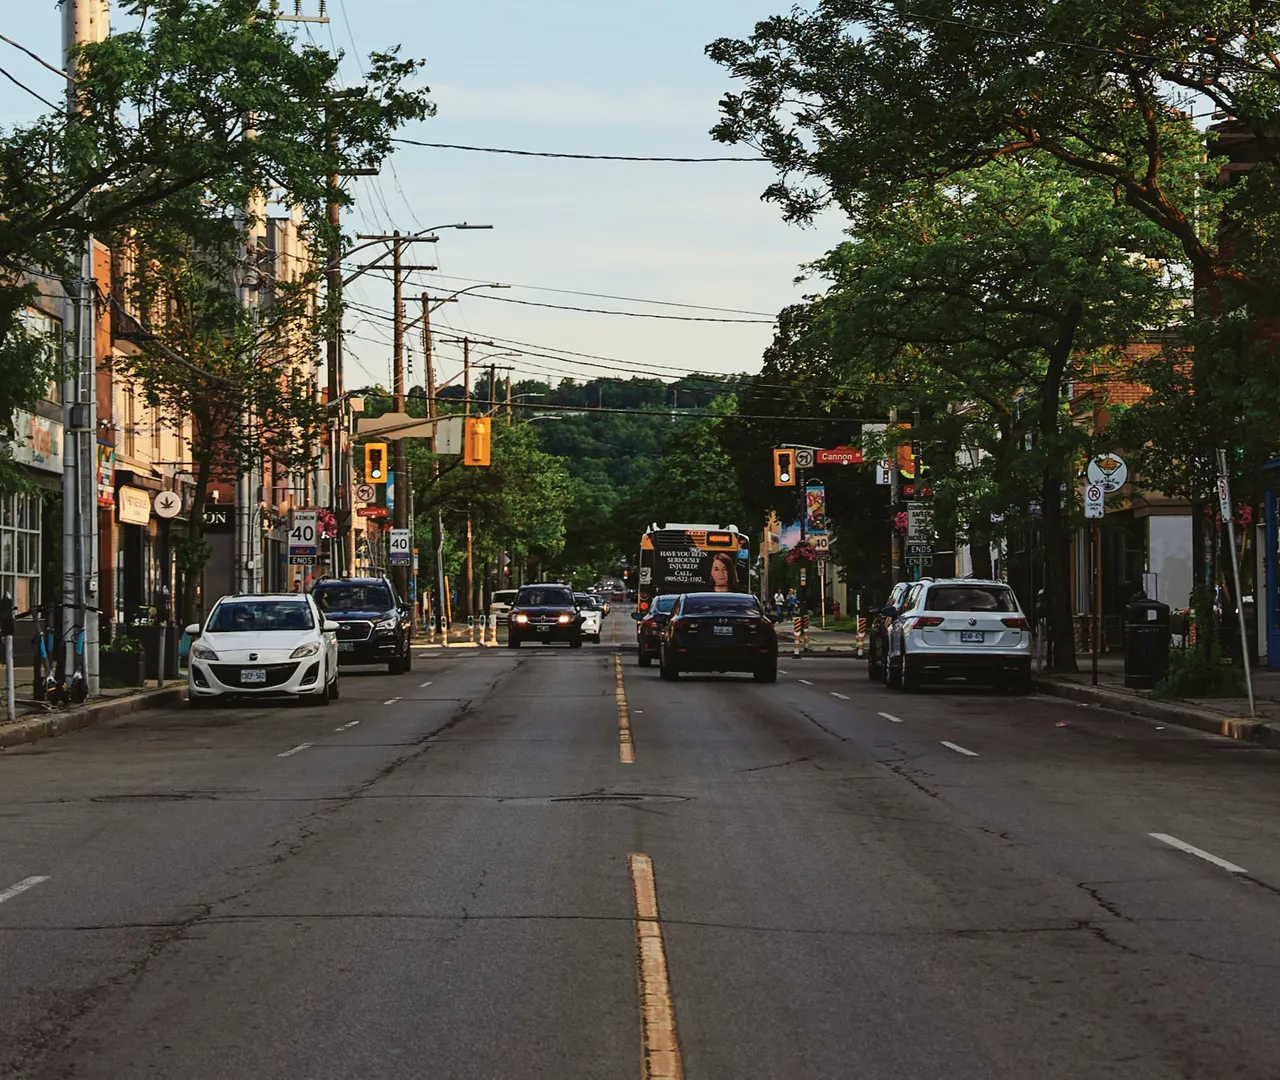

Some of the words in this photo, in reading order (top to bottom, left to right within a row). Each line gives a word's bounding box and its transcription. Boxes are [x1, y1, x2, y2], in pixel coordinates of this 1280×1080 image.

[822, 453, 852, 461] Cannon
[291, 526, 314, 541] 40
[391, 538, 408, 550] 40
[911, 545, 932, 553] ENDS
[292, 556, 312, 565] ENDS
[909, 558, 928, 566] ENS
